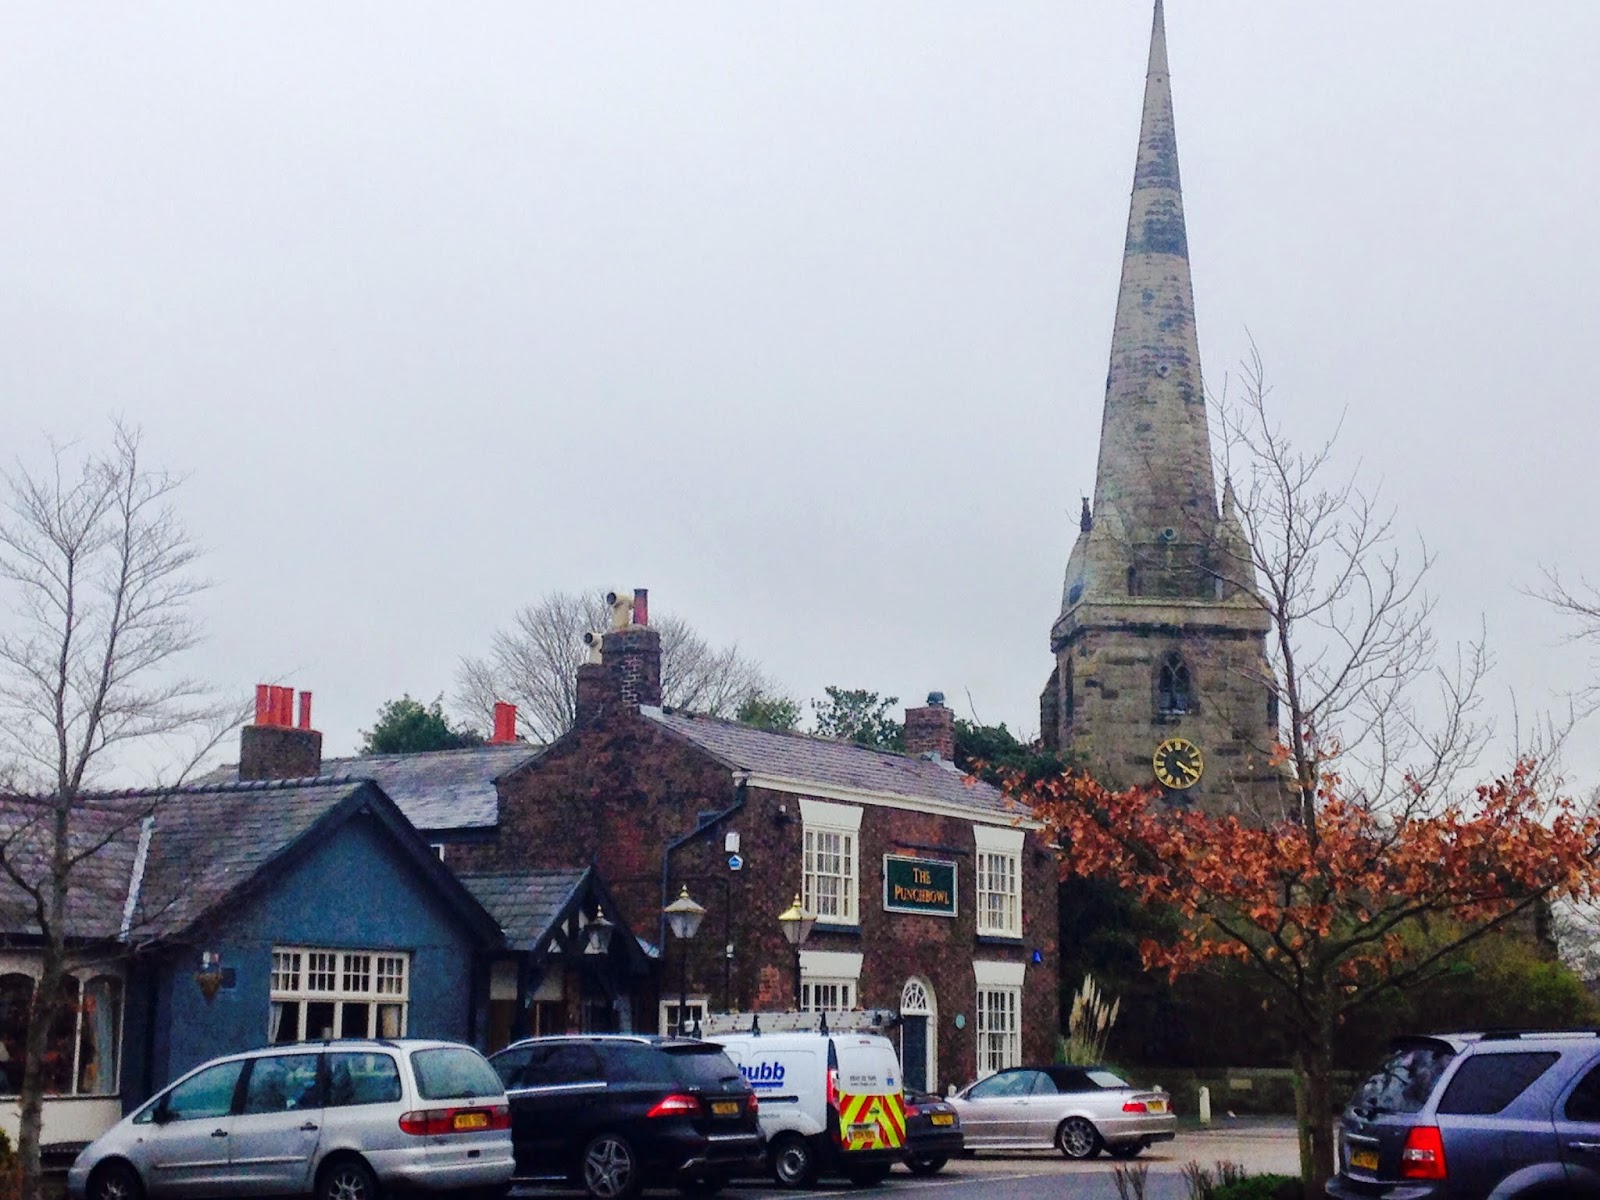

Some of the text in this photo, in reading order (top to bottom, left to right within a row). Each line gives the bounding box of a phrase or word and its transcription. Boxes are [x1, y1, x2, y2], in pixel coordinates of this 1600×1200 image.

[913, 867, 932, 885] THE
[894, 884, 950, 905] PUNCHBOWL
[738, 1061, 785, 1080] hubb
